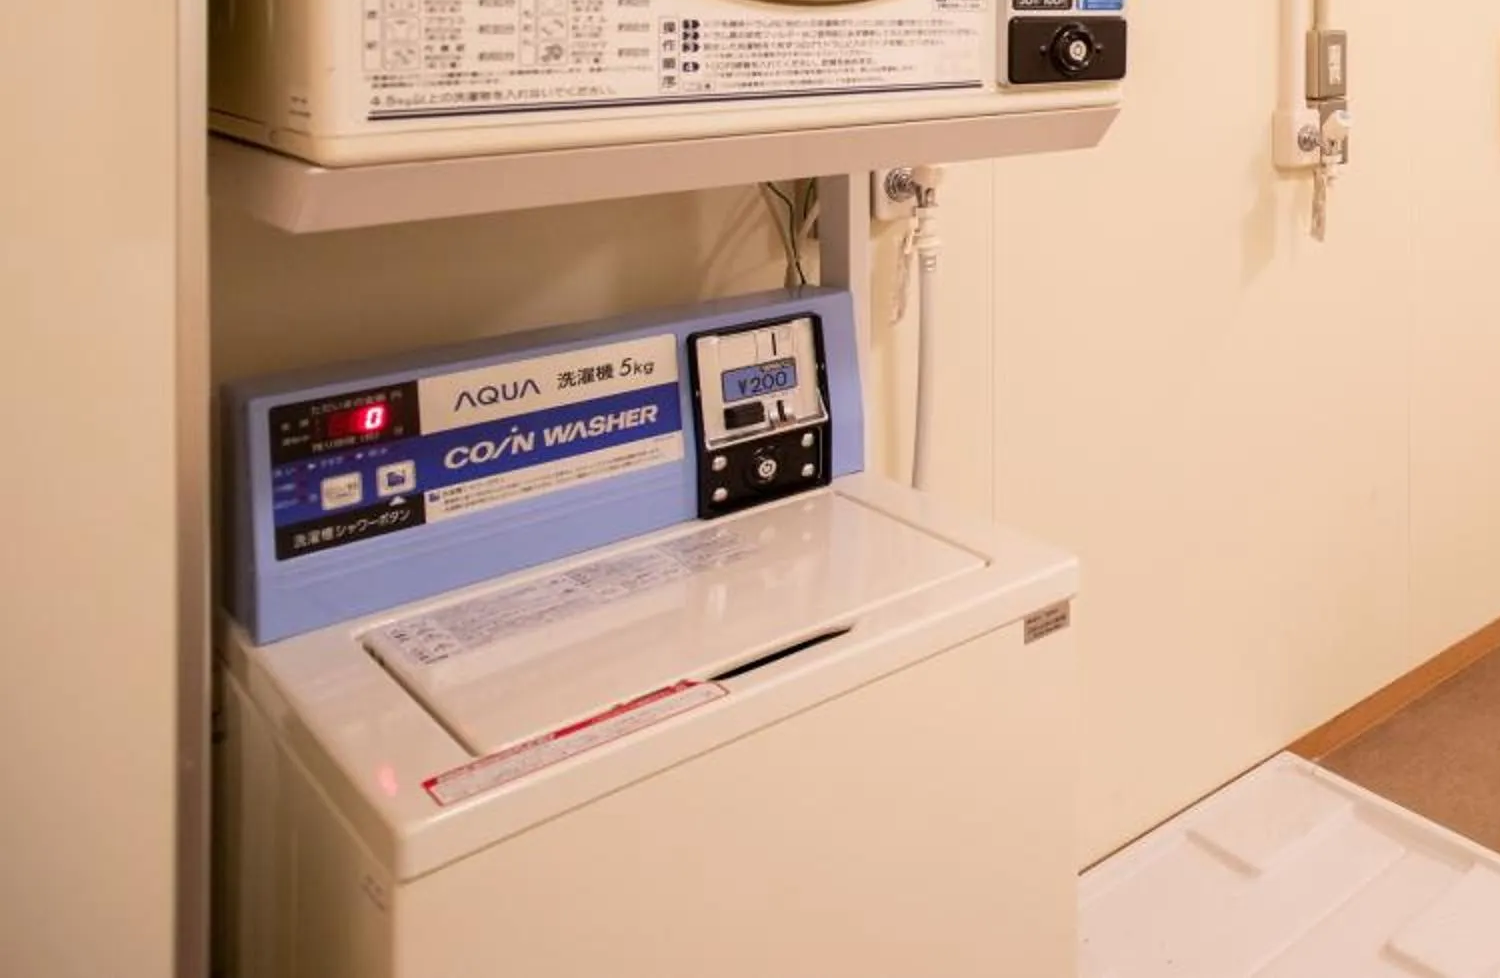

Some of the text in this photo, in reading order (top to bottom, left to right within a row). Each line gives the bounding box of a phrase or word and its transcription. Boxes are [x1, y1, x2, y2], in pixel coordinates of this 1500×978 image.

[556, 357, 655, 390] 洗濯機 5kg
[454, 379, 541, 412] AQUA
[364, 407, 385, 430] 0
[543, 404, 660, 447] WASHER
